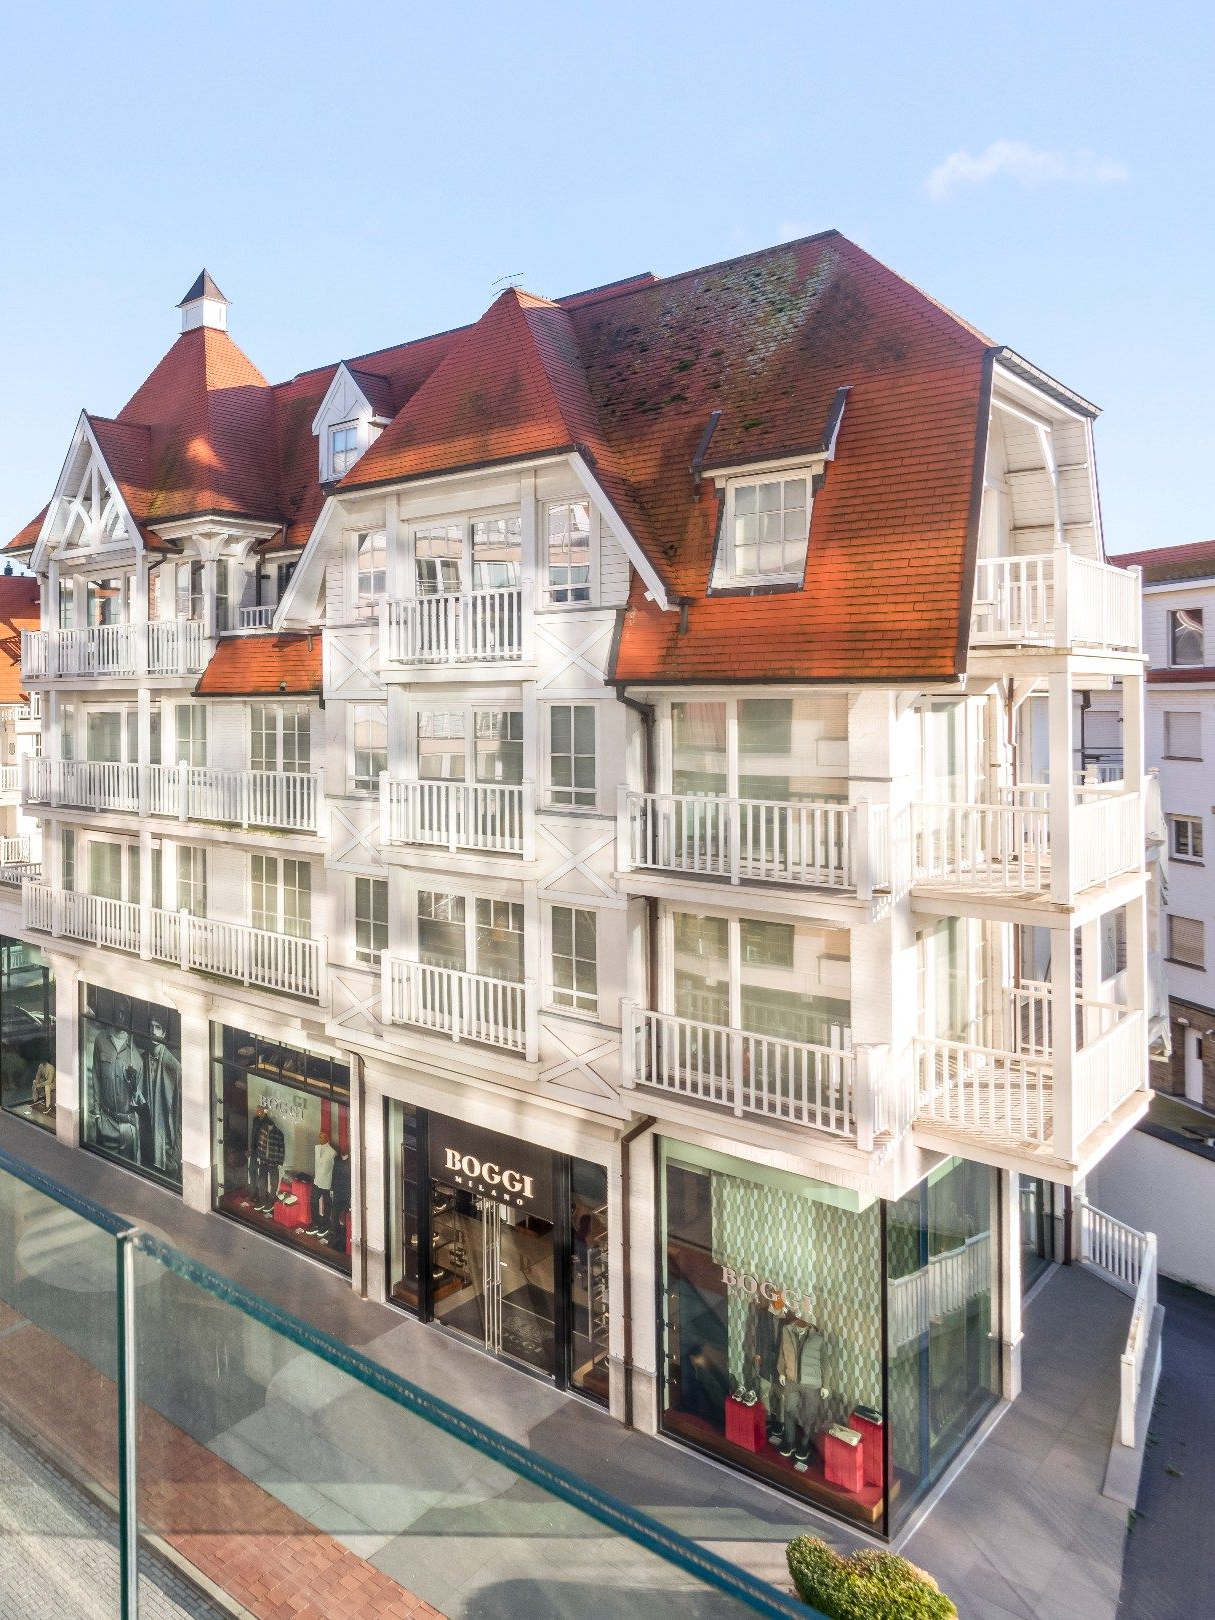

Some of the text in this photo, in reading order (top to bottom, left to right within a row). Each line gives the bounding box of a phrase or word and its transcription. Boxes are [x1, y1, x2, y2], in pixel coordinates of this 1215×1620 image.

[259, 1095, 305, 1120] BOGGI
[445, 1148, 533, 1198] BOGGI
[455, 1175, 523, 1205] MILANO
[721, 1265, 812, 1313] BOGGI
